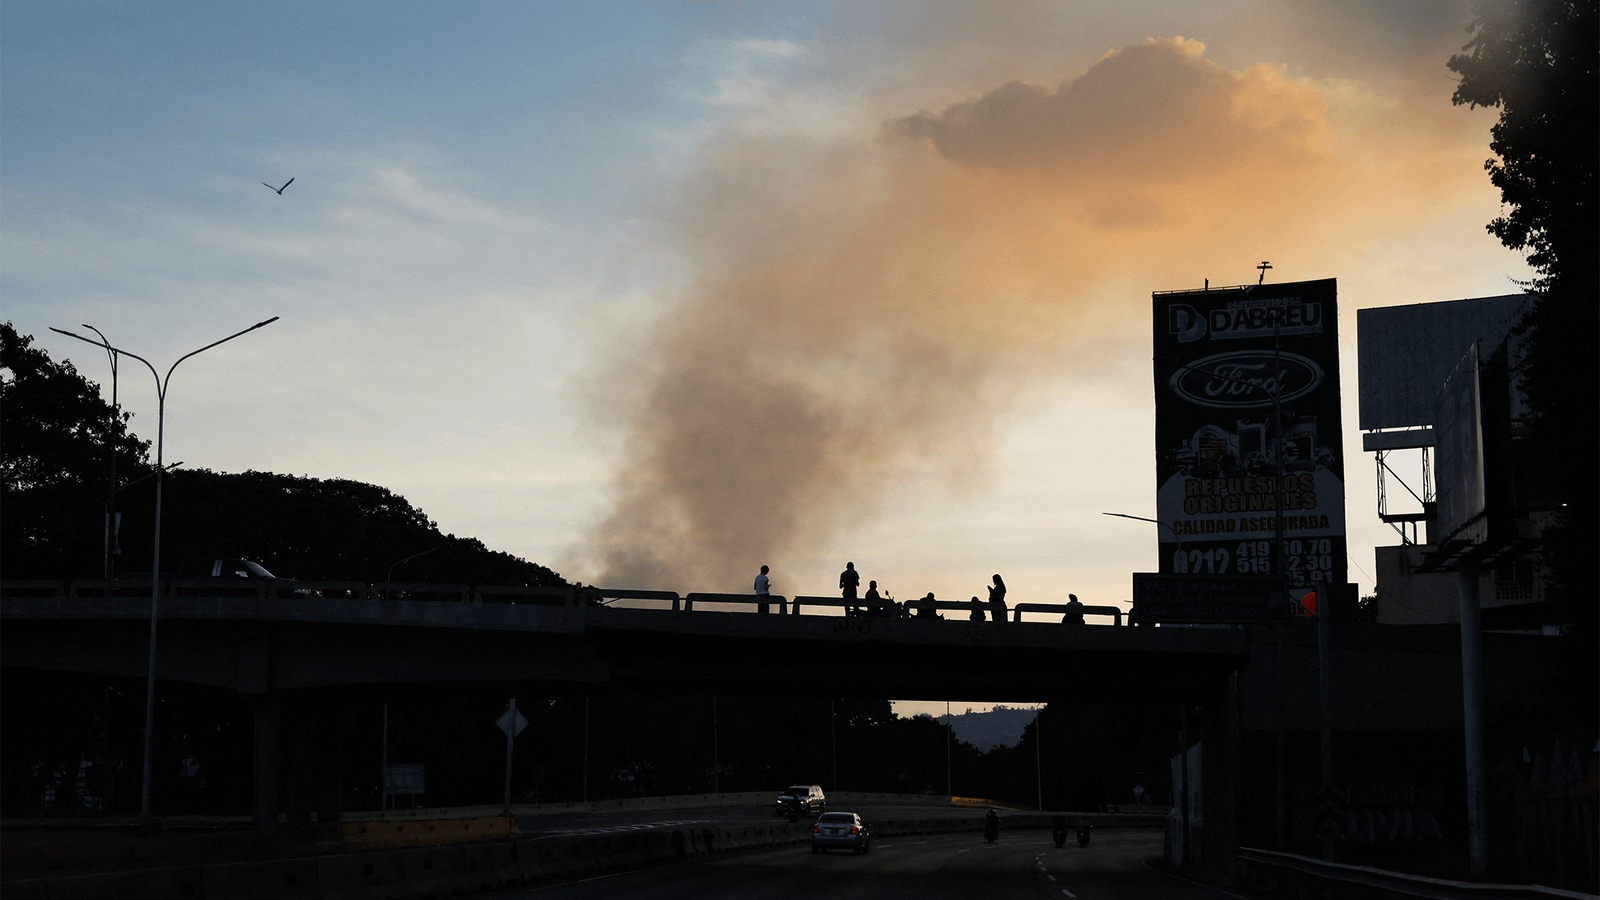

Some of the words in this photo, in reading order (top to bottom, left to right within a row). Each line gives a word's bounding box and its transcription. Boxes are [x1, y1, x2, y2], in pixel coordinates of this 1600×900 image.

[1205, 363, 1287, 396] Ford
[1173, 518, 1236, 535] CALIDAD
[1143, 582, 1185, 591] VALLE
[1167, 594, 1193, 603] LOS
